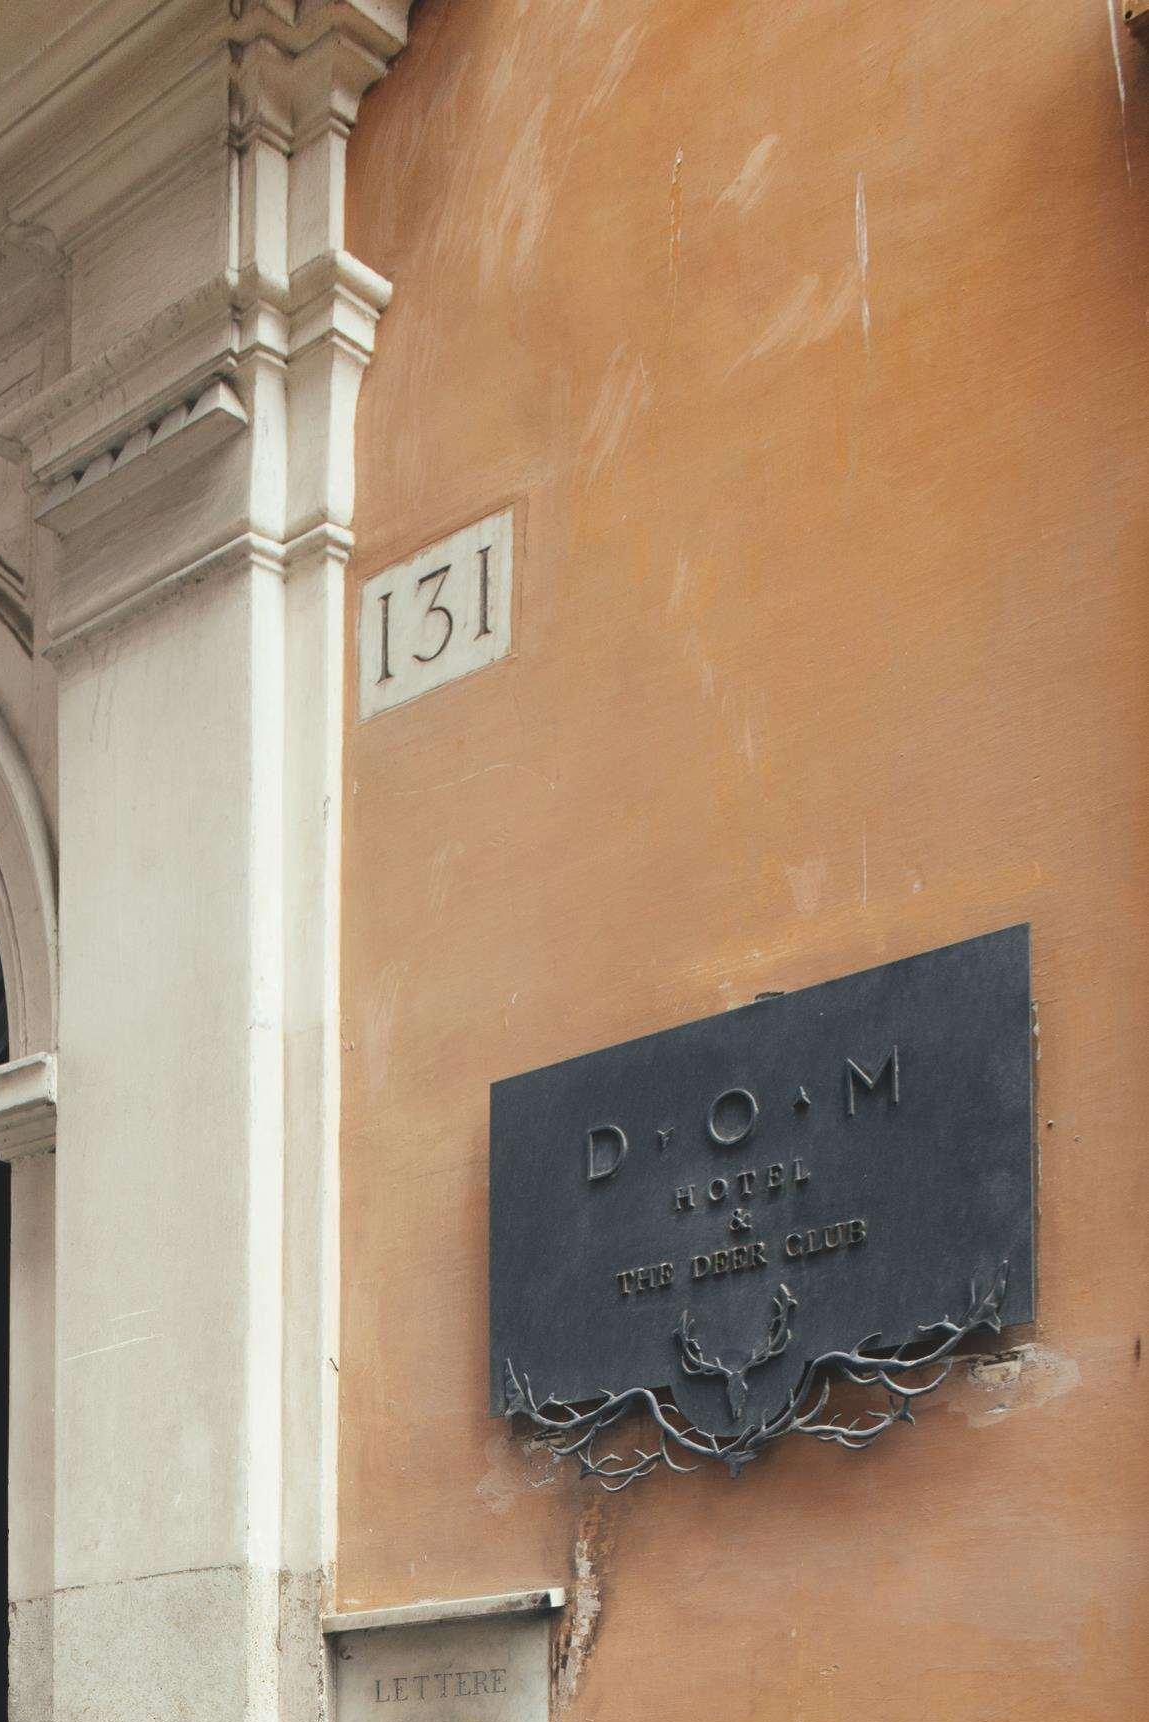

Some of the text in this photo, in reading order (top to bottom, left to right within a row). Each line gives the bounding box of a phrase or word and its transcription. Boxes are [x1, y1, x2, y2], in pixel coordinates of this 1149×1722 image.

[375, 545, 492, 685] 131
[674, 1157, 811, 1212] HOTEL
[729, 1207, 753, 1232] &
[613, 1218, 868, 1296] THE DEER CLUB
[374, 1668, 508, 1704] LETTERE
